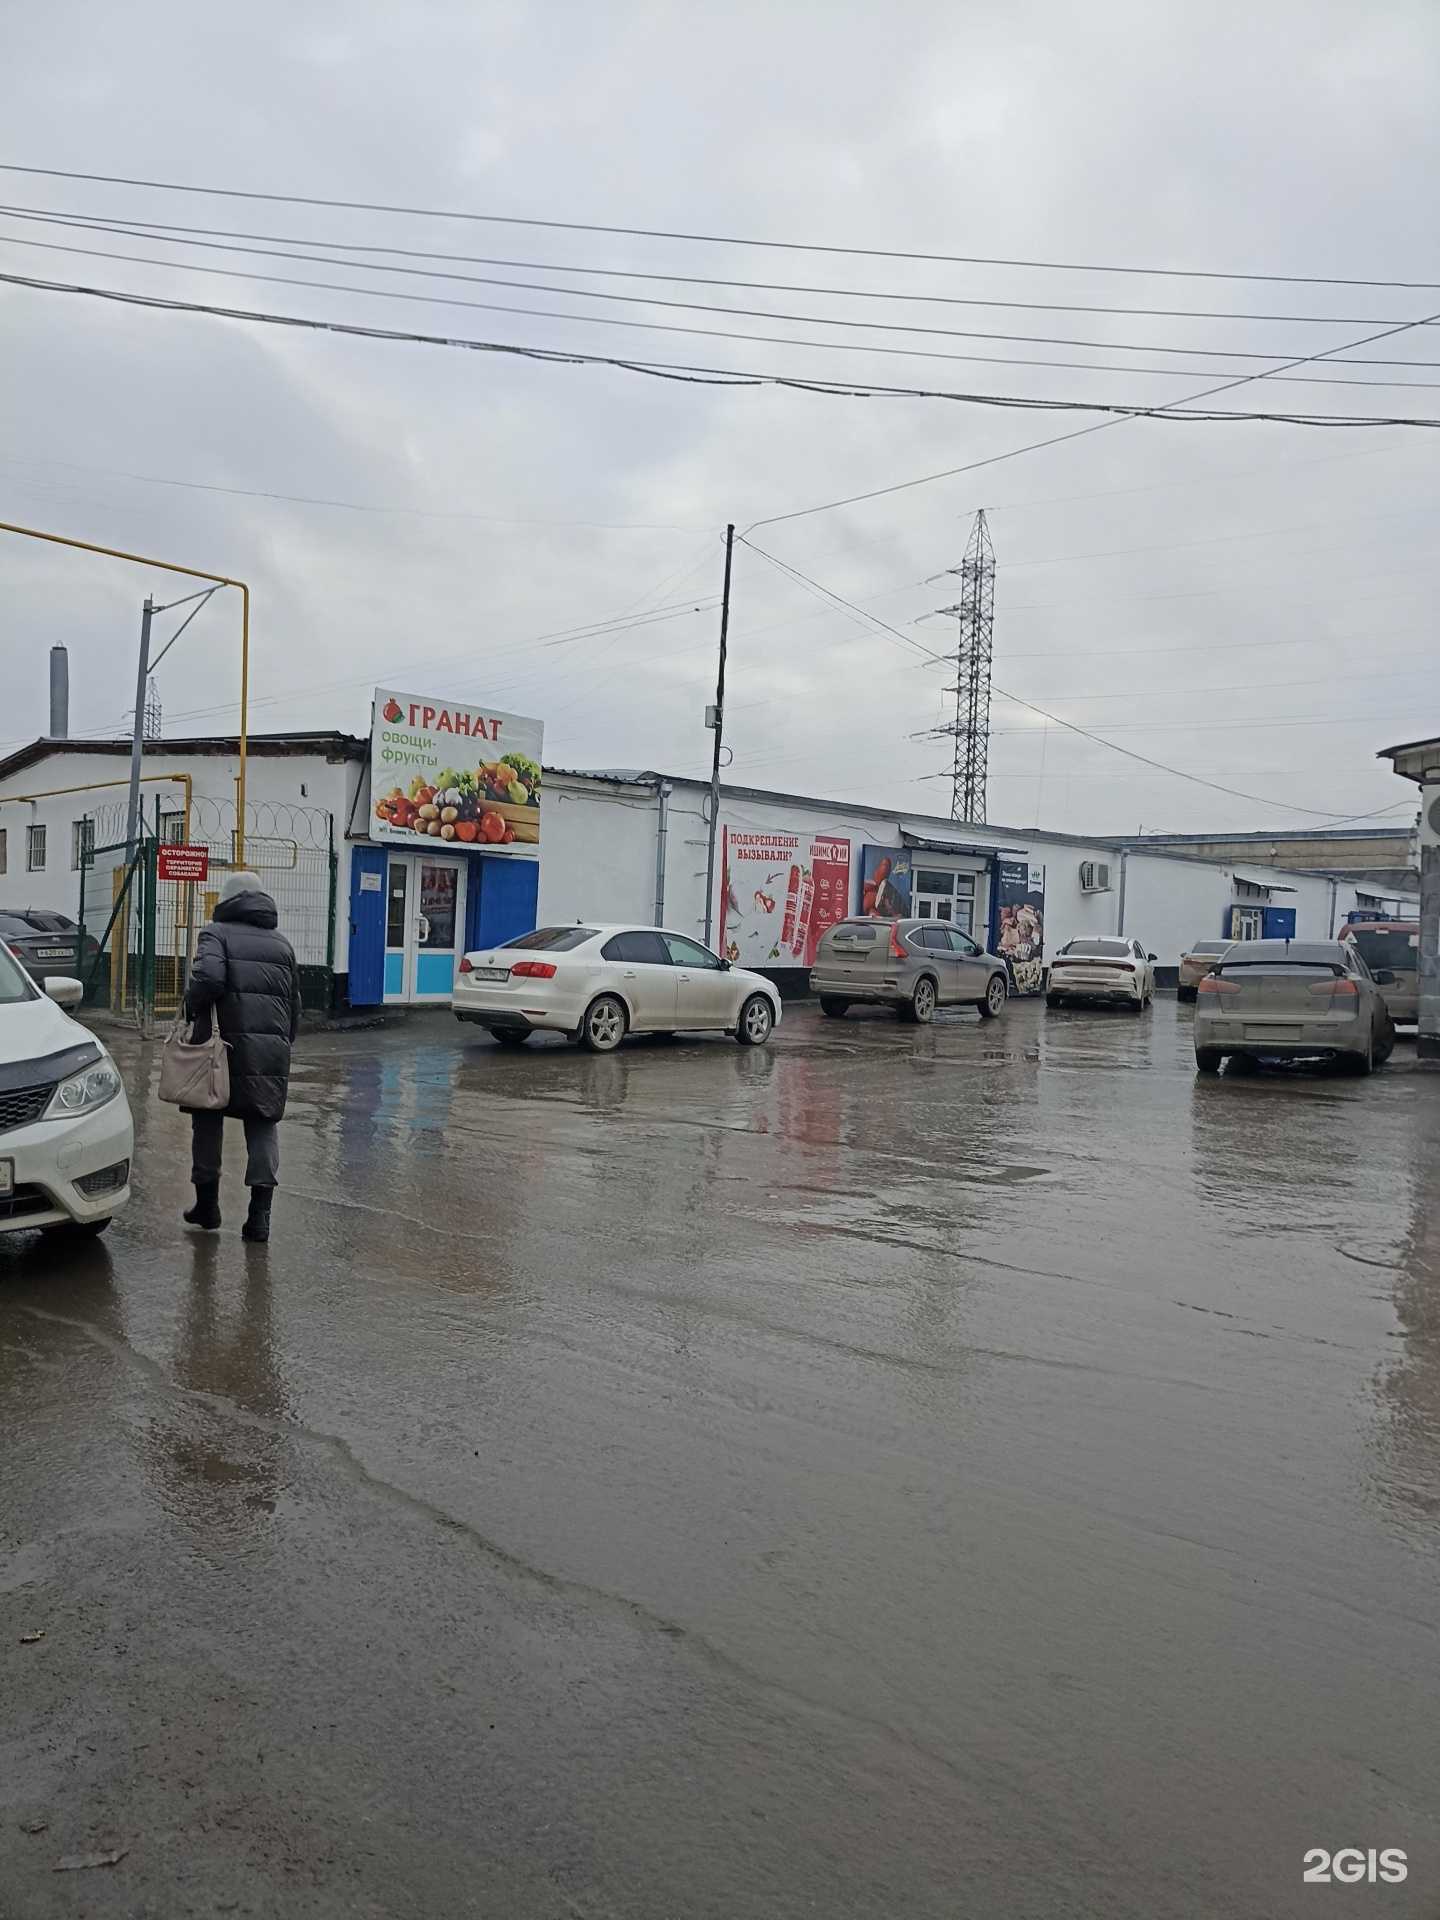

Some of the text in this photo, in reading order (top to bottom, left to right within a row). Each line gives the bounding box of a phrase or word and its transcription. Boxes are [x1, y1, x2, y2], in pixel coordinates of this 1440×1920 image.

[409, 704, 503, 741] ГРАНАТ
[382, 747, 438, 766] фрукты
[730, 834, 799, 848] ПОДКРЕПЛЕНИЕ
[161, 849, 207, 857] ОСТОРОЖНО!
[737, 849, 793, 861] ВЫЗЫВАЛИ?
